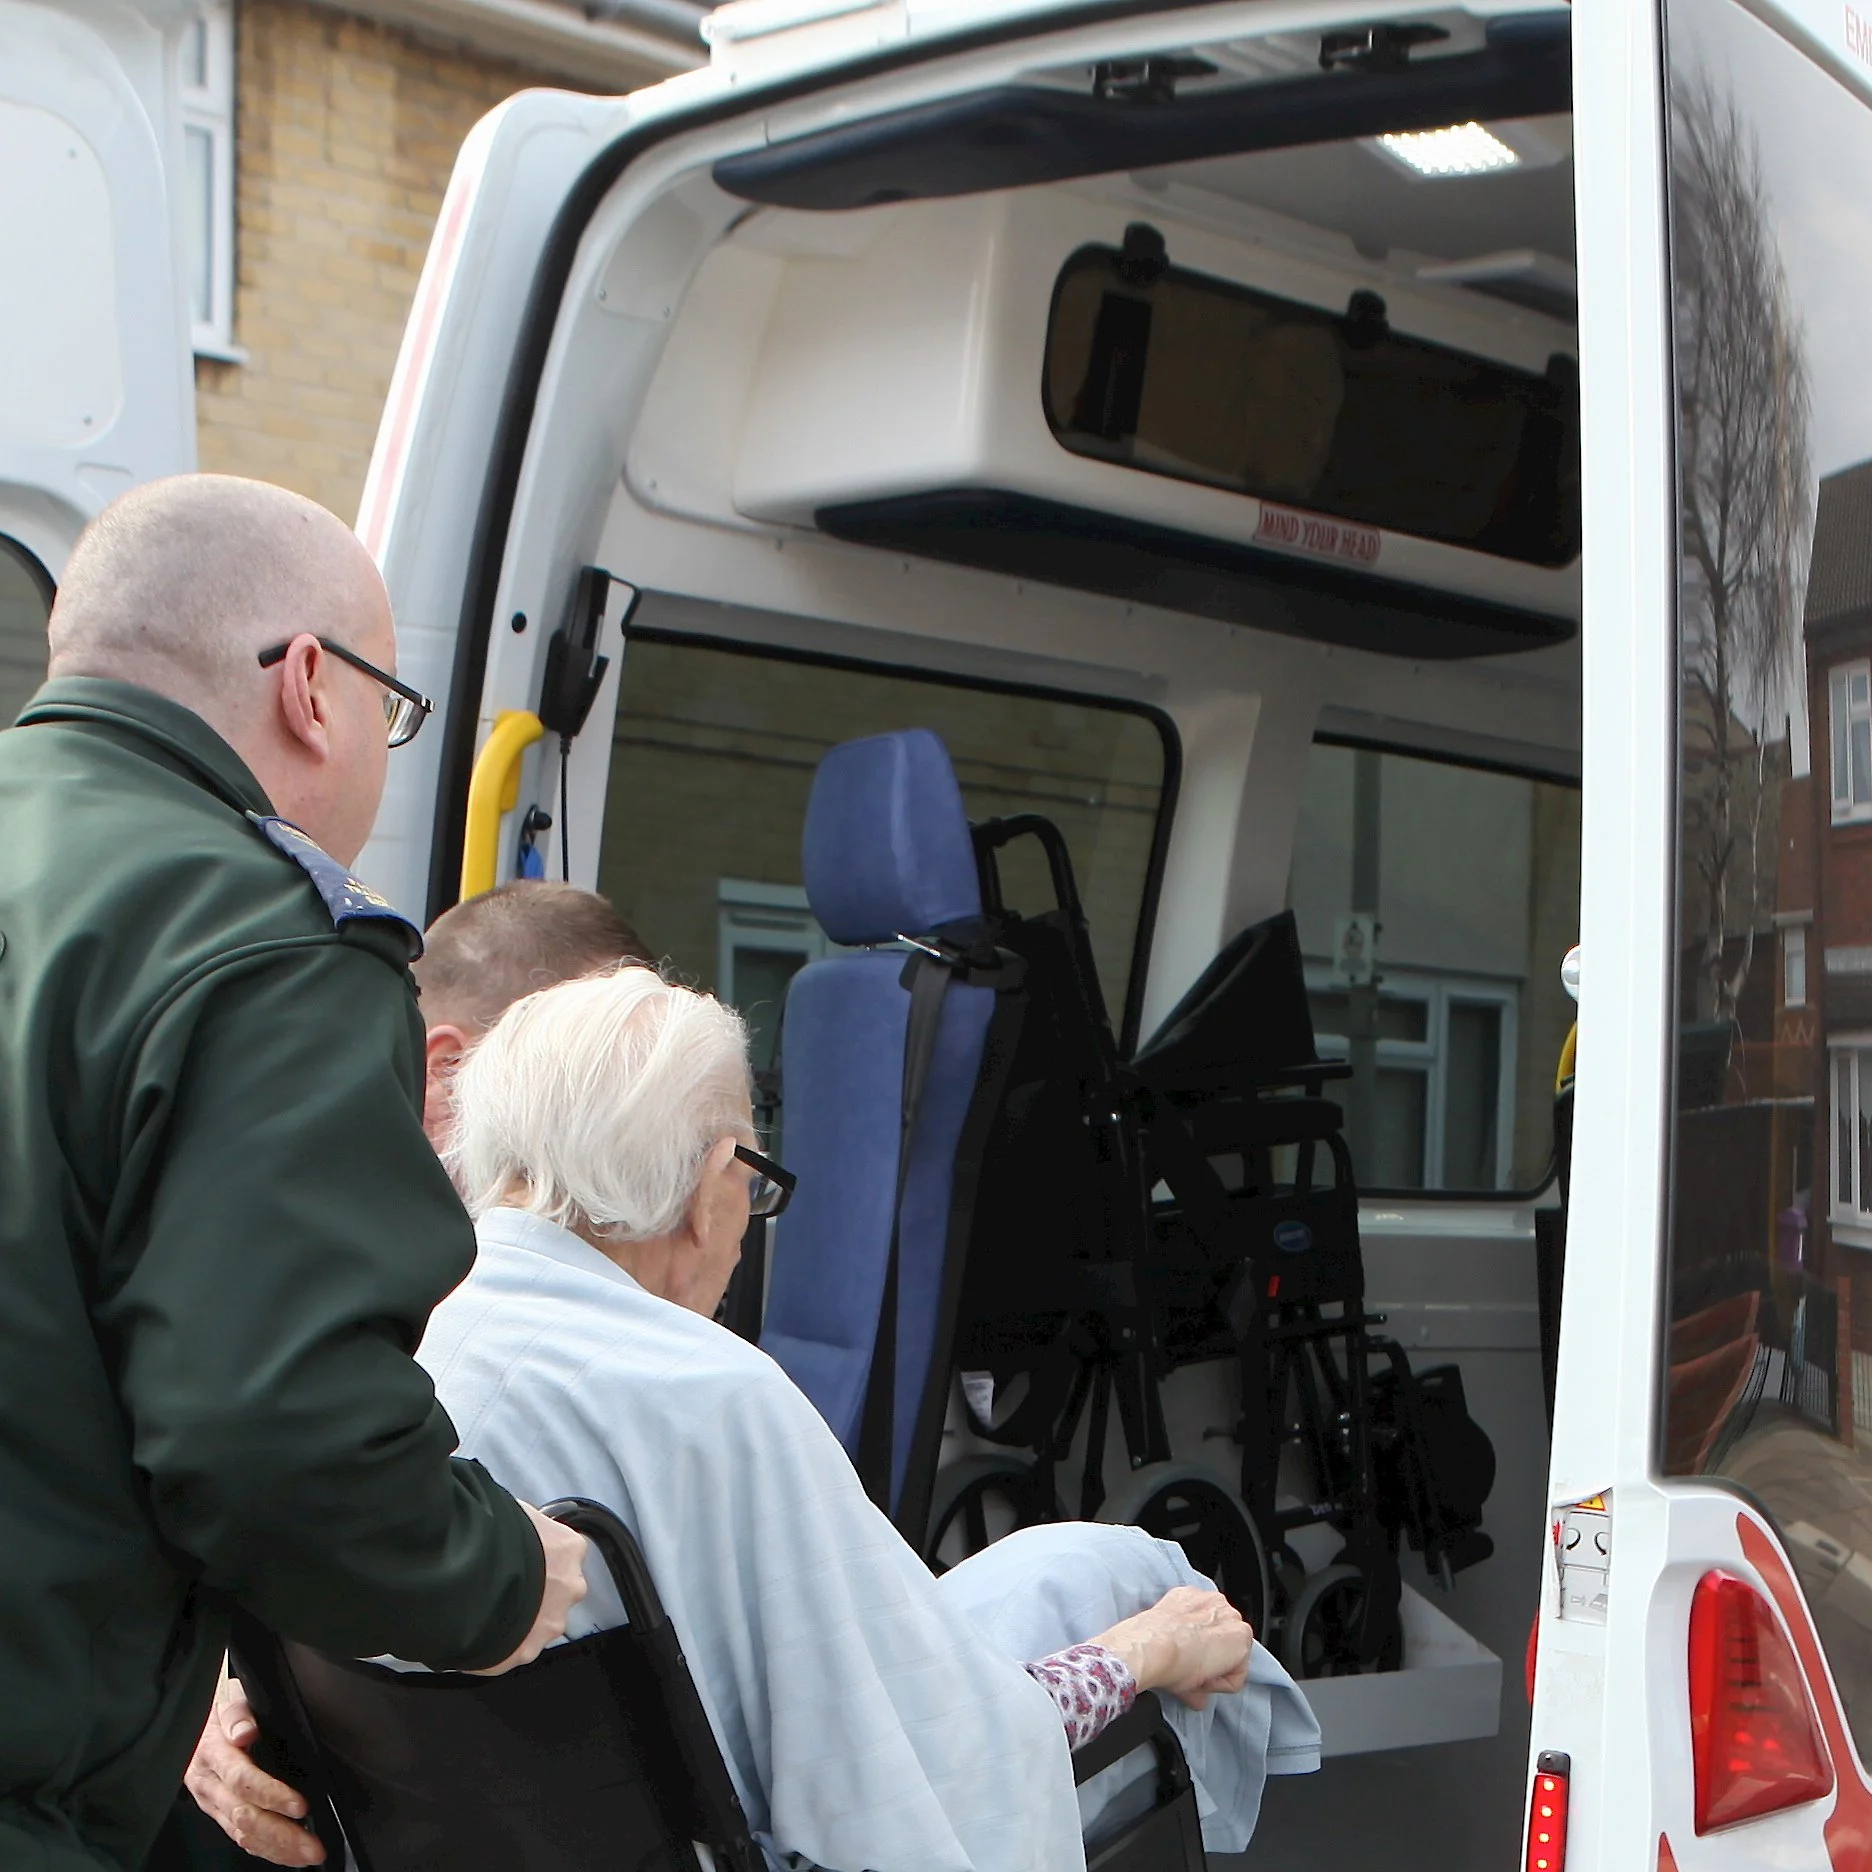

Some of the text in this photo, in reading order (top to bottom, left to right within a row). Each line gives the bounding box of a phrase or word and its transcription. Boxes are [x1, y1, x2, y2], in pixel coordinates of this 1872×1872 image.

[1261, 511, 1377, 562] MIND YOUR HEAD
